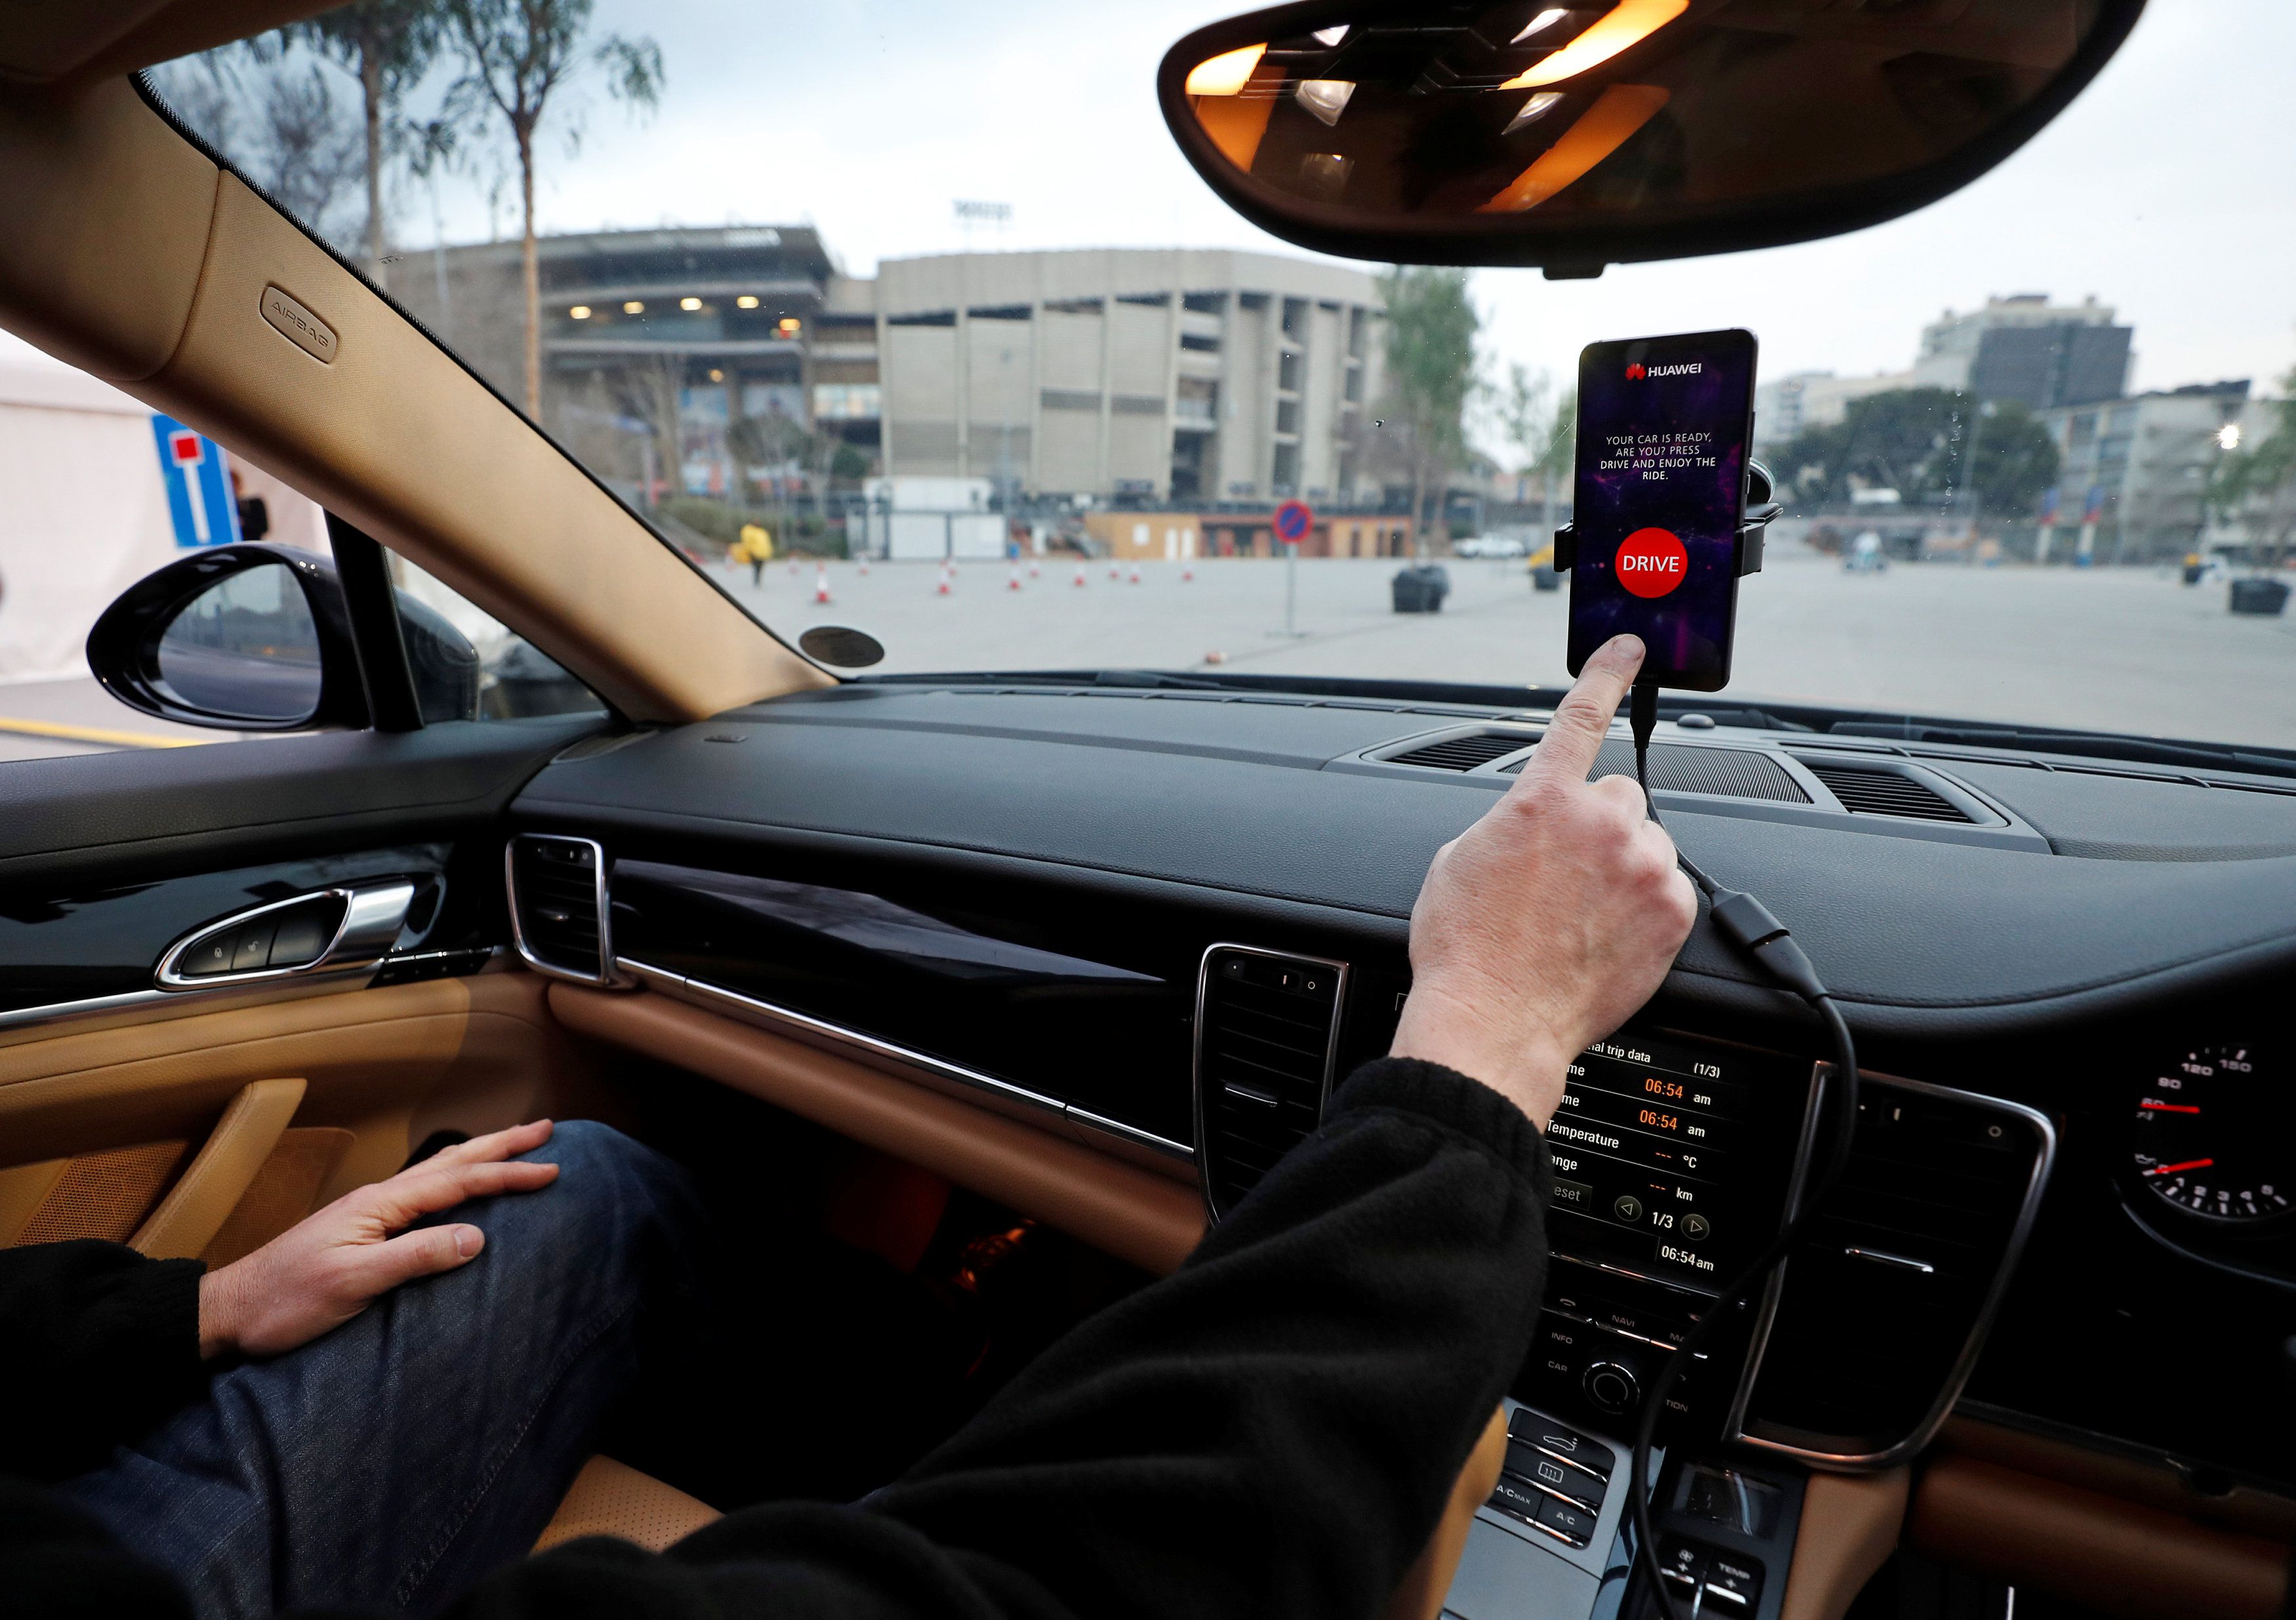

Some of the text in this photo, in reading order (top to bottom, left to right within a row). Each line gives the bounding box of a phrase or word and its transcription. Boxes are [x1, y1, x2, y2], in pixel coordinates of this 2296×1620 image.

[270, 302, 329, 348] AIRBAG
[1648, 363, 1702, 378] HUAWEI
[1606, 432, 1712, 445] YOUR CAR IS READY,
[1615, 445, 1700, 457] ARE YOU? PRESS
[1601, 457, 1716, 470] DRIVE AND ENJOY THE
[1642, 471, 1668, 480] RIDE.
[1622, 555, 1680, 573] DRIVE
[1607, 1045, 1625, 1059] trip
[1628, 1049, 1651, 1063] data
[1693, 1062, 1720, 1079] (1/3)
[1567, 1064, 1711, 1105] me 06:54 am
[2158, 1077, 2181, 1089] 90
[1561, 1094, 1706, 1137] me 06:54 am
[1548, 1119, 1619, 1148] Temperature
[1683, 1154, 1697, 1169] °C
[1553, 1186, 1581, 1202] eset
[1675, 1186, 1693, 1201] km
[1652, 1211, 1673, 1228] 1/3
[1612, 1314, 1635, 1327] NAVI
[1551, 1332, 1573, 1345] INFO
[1548, 1360, 1568, 1373] CAR
[1666, 1399, 1689, 1412] TION
[1556, 1511, 1576, 1526] A/C
